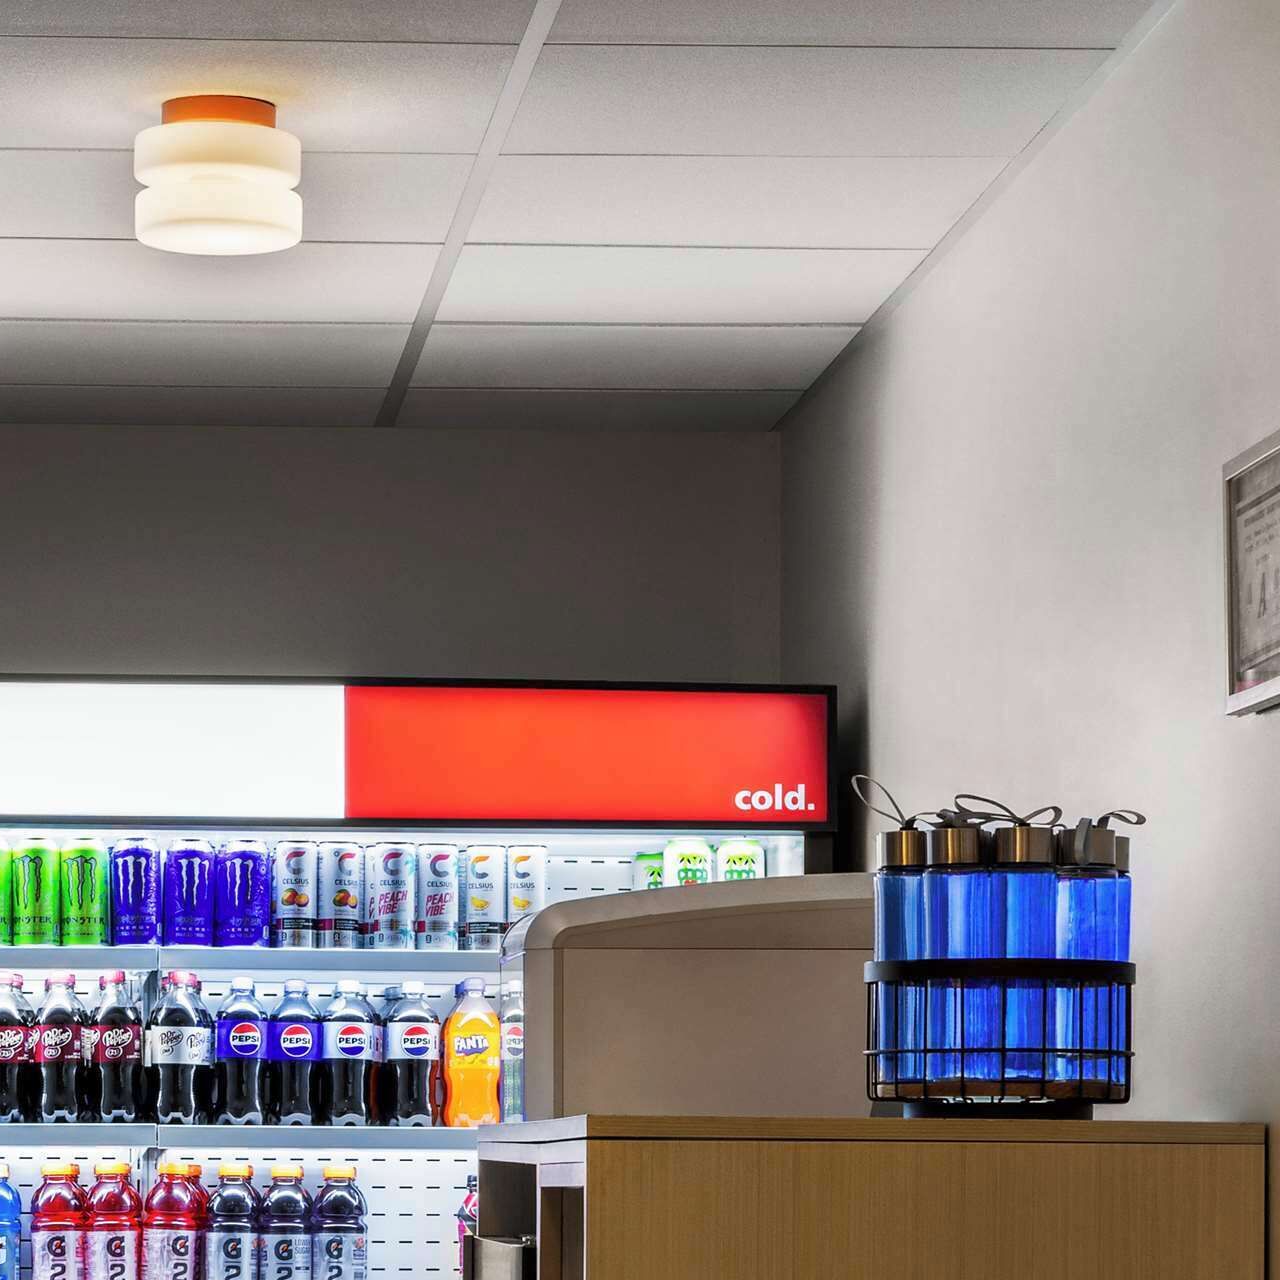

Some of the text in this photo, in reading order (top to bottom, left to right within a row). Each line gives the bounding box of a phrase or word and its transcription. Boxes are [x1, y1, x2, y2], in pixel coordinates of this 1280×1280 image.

[734, 783, 816, 811] cold.
[379, 889, 408, 904] PEACH
[377, 901, 398, 917] VIBE
[425, 903, 446, 917] VIBE
[231, 1034, 260, 1043] PEPSI
[282, 1036, 311, 1045] PEPSI
[338, 1037, 365, 1046] PEPSI
[403, 1037, 430, 1046] PEPSI
[47, 1235, 66, 1258] G
[106, 1235, 126, 1258] G
[171, 1235, 190, 1258] G
[222, 1237, 242, 1260] G
[274, 1239, 293, 1261] G
[325, 1237, 343, 1260] G
